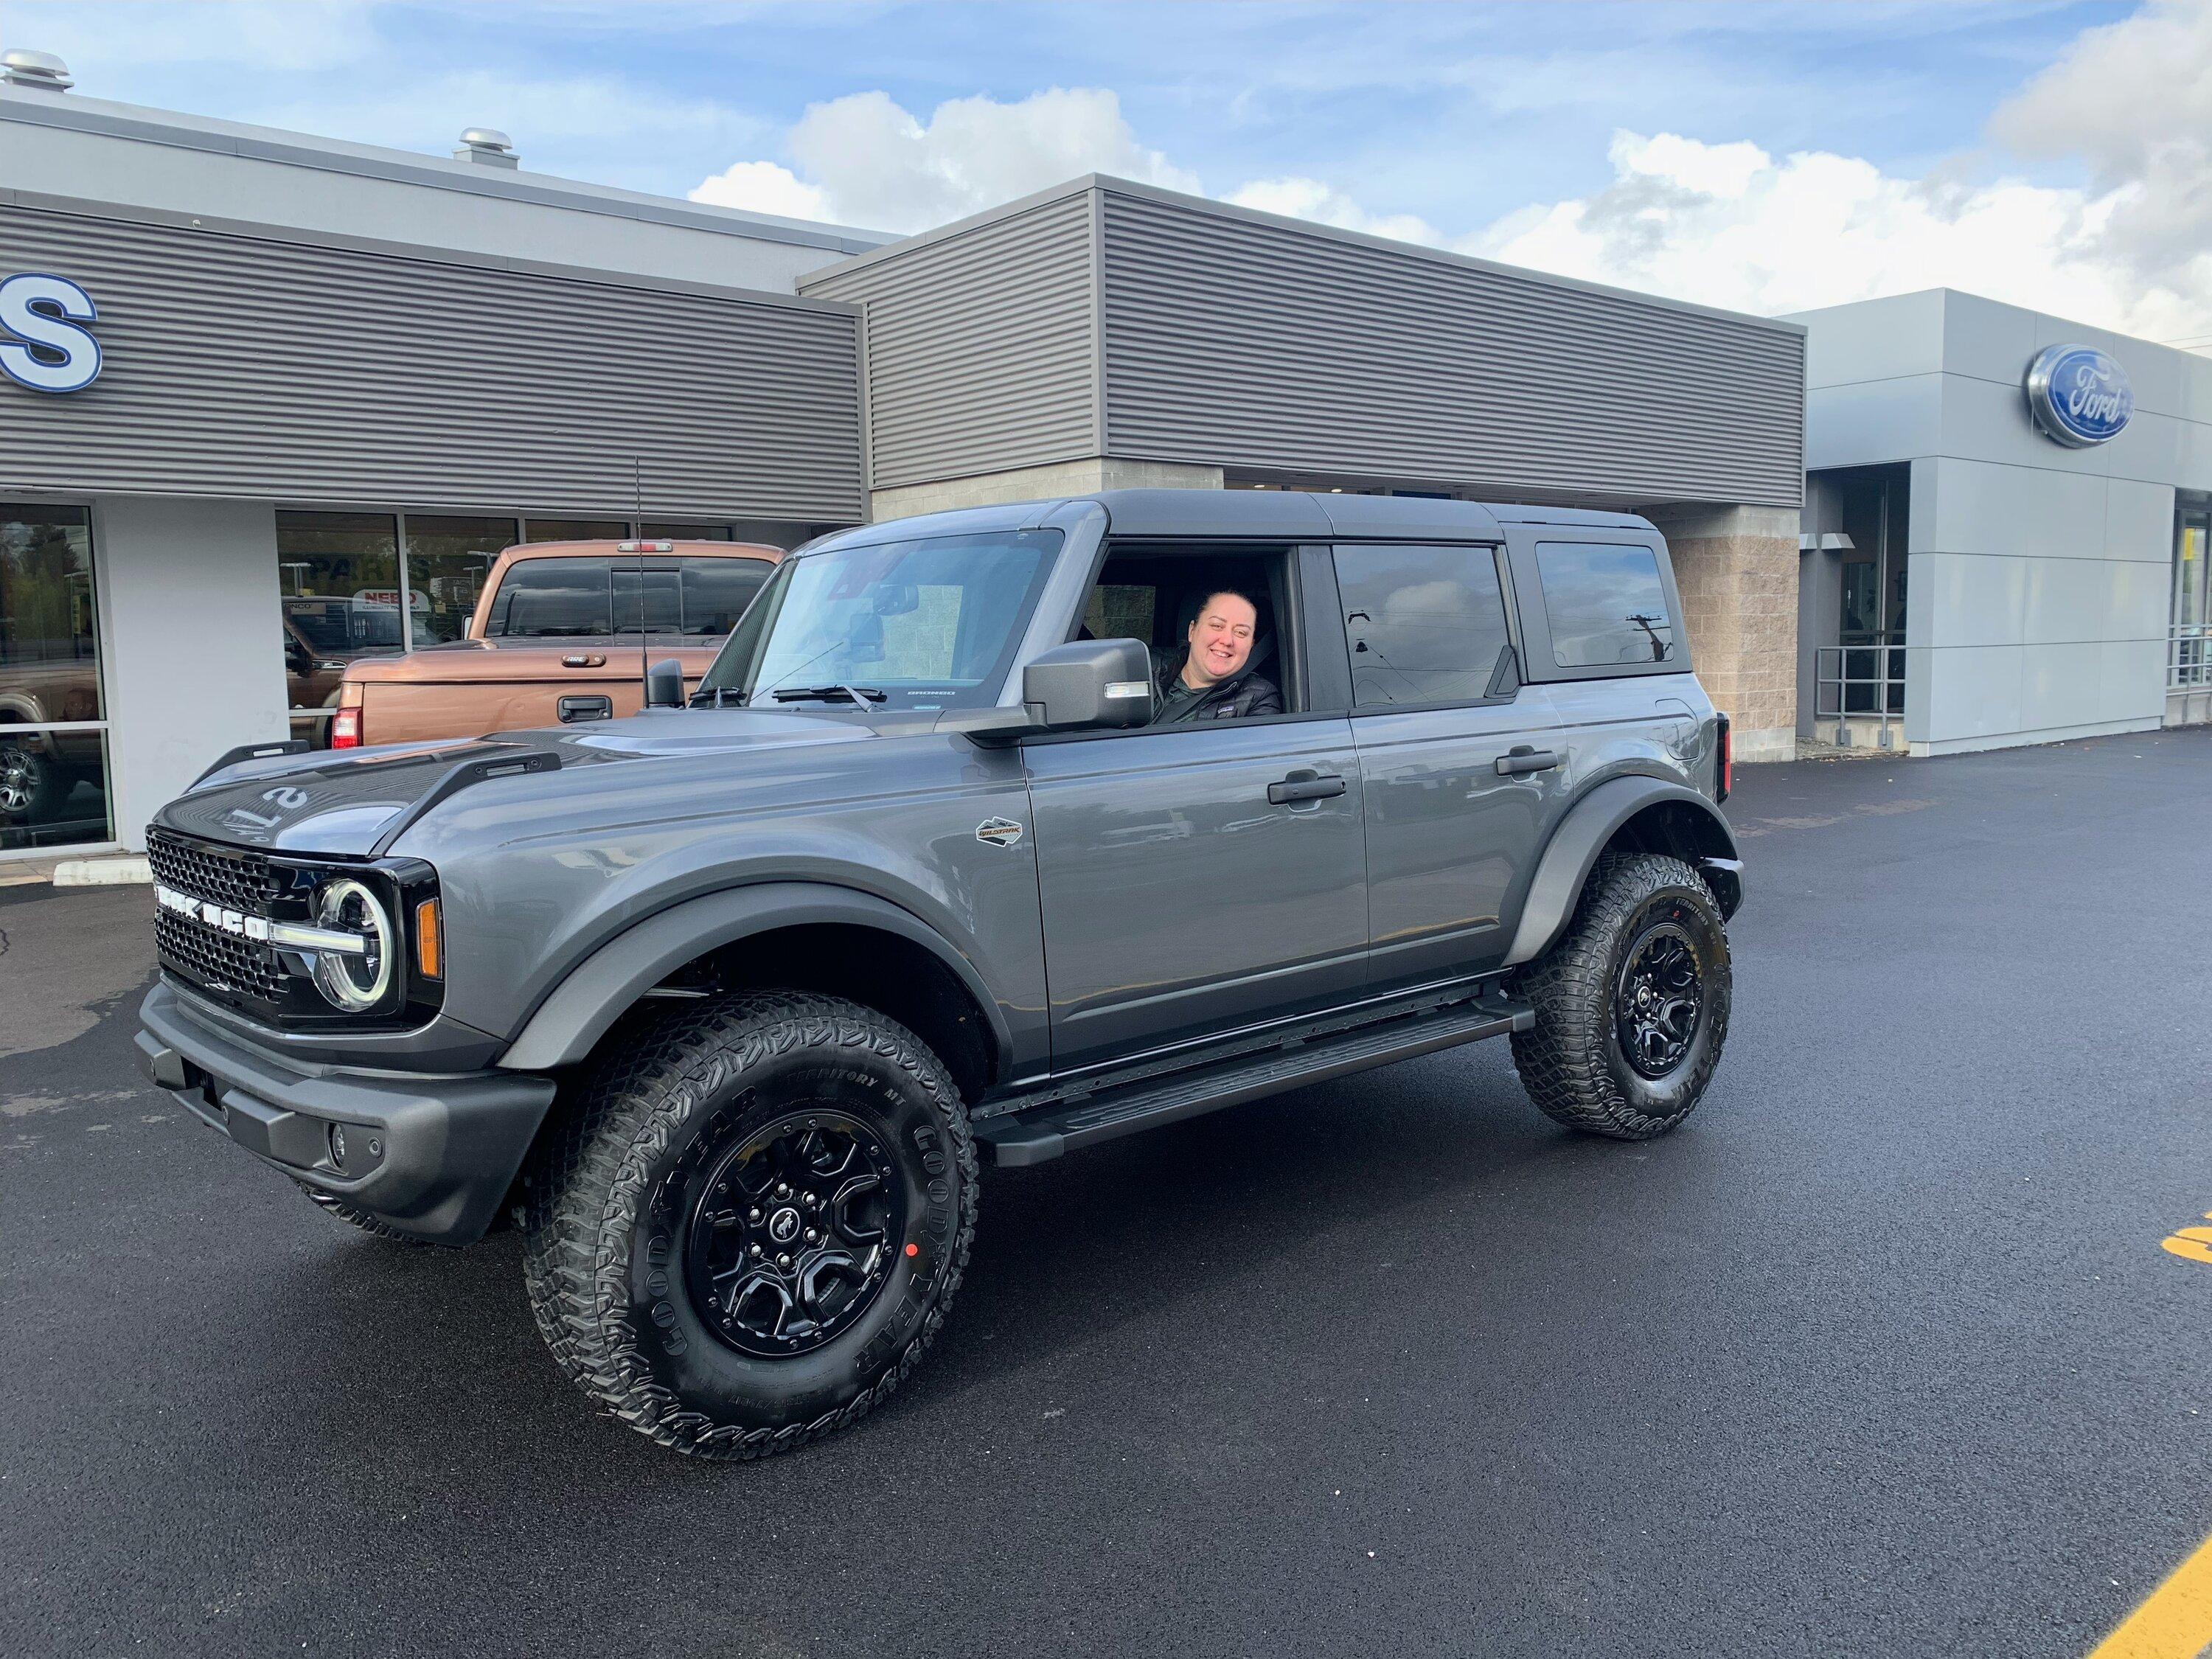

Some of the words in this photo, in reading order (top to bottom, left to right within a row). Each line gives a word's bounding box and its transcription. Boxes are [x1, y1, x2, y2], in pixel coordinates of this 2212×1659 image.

[0, 272, 102, 393] S
[2070, 365, 2122, 424] Ford
[883, 1088, 907, 1107] MT
